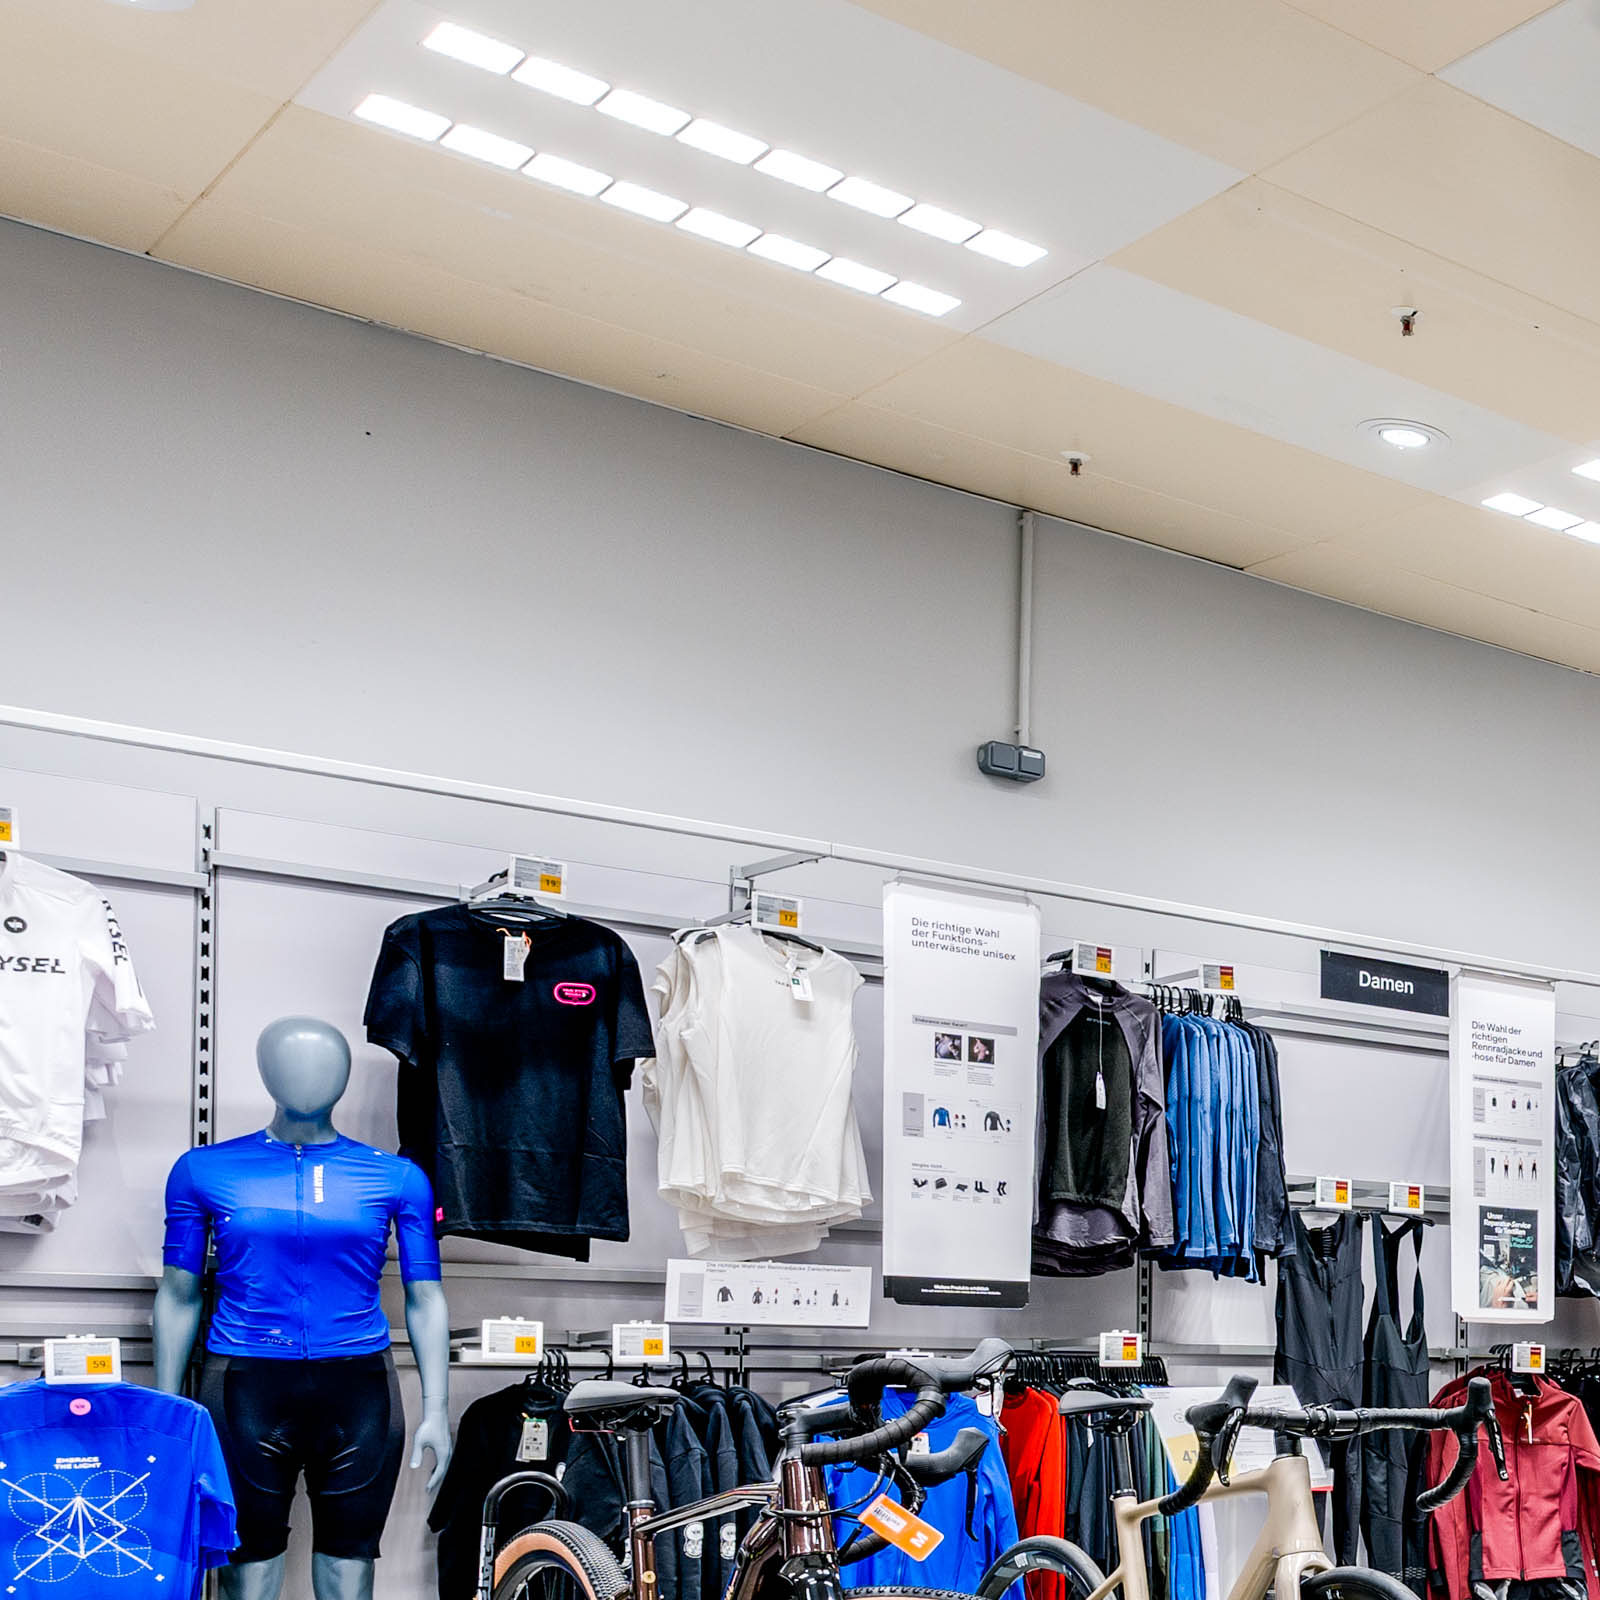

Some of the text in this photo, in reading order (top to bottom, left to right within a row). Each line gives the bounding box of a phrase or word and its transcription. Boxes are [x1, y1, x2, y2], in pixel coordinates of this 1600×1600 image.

[912, 917, 1000, 938] Die richtige Wahl
[912, 928, 988, 947] der Funktions-
[912, 940, 1016, 961] unterwäsche unisex
[1359, 970, 1414, 994] Damen
[1471, 1020, 1522, 1035] Die Wahl der
[1471, 1033, 1508, 1044] richtigen
[1471, 1041, 1543, 1058] Rennradjacke und
[1472, 1052, 1536, 1067] -hose für Damen
[520, 1340, 531, 1348] 19
[93, 1360, 106, 1369] 59
[55, 1456, 100, 1464] EMBRACE
[73, 1462, 102, 1470] LIGHT
